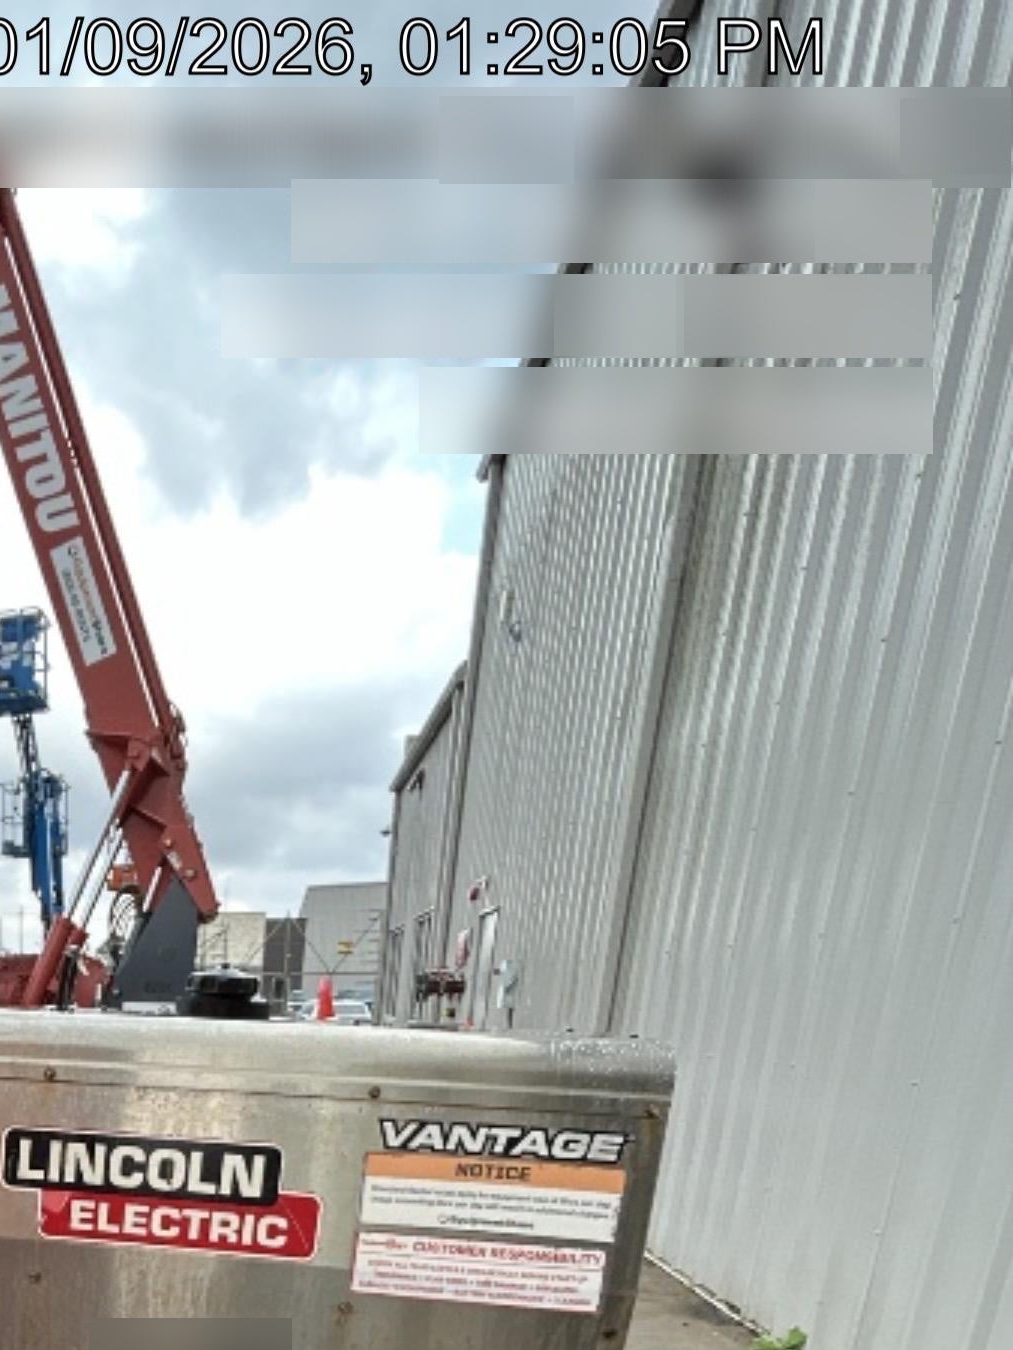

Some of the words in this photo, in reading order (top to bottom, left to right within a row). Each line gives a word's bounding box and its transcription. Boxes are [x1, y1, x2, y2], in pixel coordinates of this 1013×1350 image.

[379, 1118, 626, 1163] VANTAGE
[16, 1137, 267, 1199] LINCOLN
[455, 1163, 531, 1182] NOTICE
[69, 1199, 289, 1249] ELECTRIC
